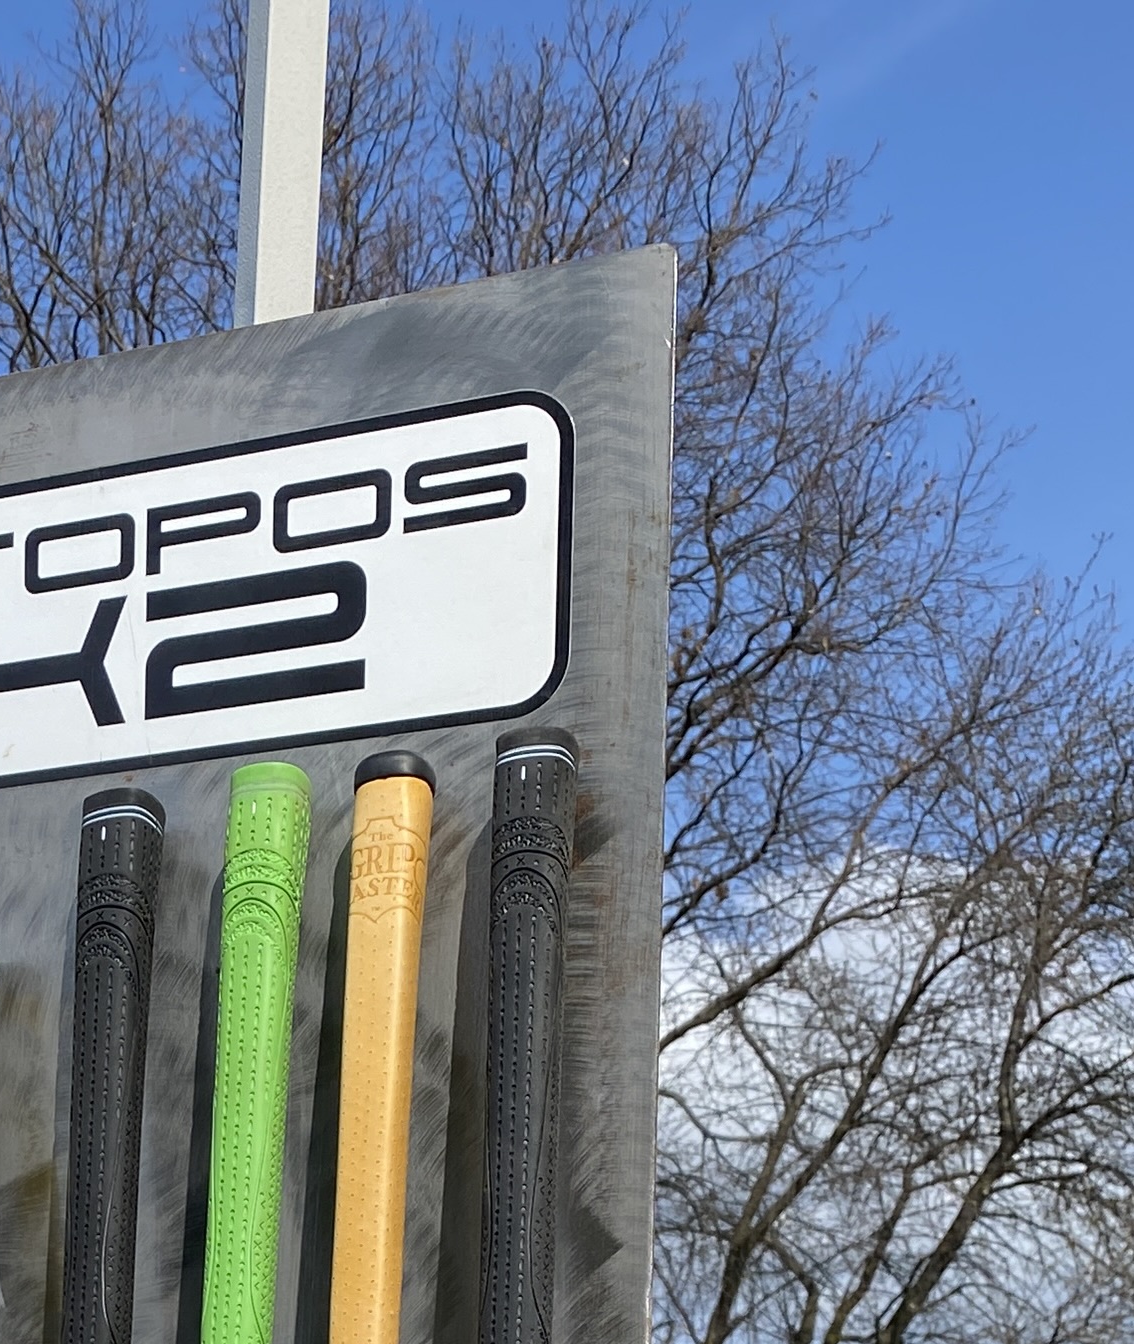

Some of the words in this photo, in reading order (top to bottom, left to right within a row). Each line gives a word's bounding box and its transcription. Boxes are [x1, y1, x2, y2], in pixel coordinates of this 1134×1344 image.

[369, 831, 394, 842] The
[351, 843, 415, 880] GRIP
[350, 876, 420, 912] ASTER
